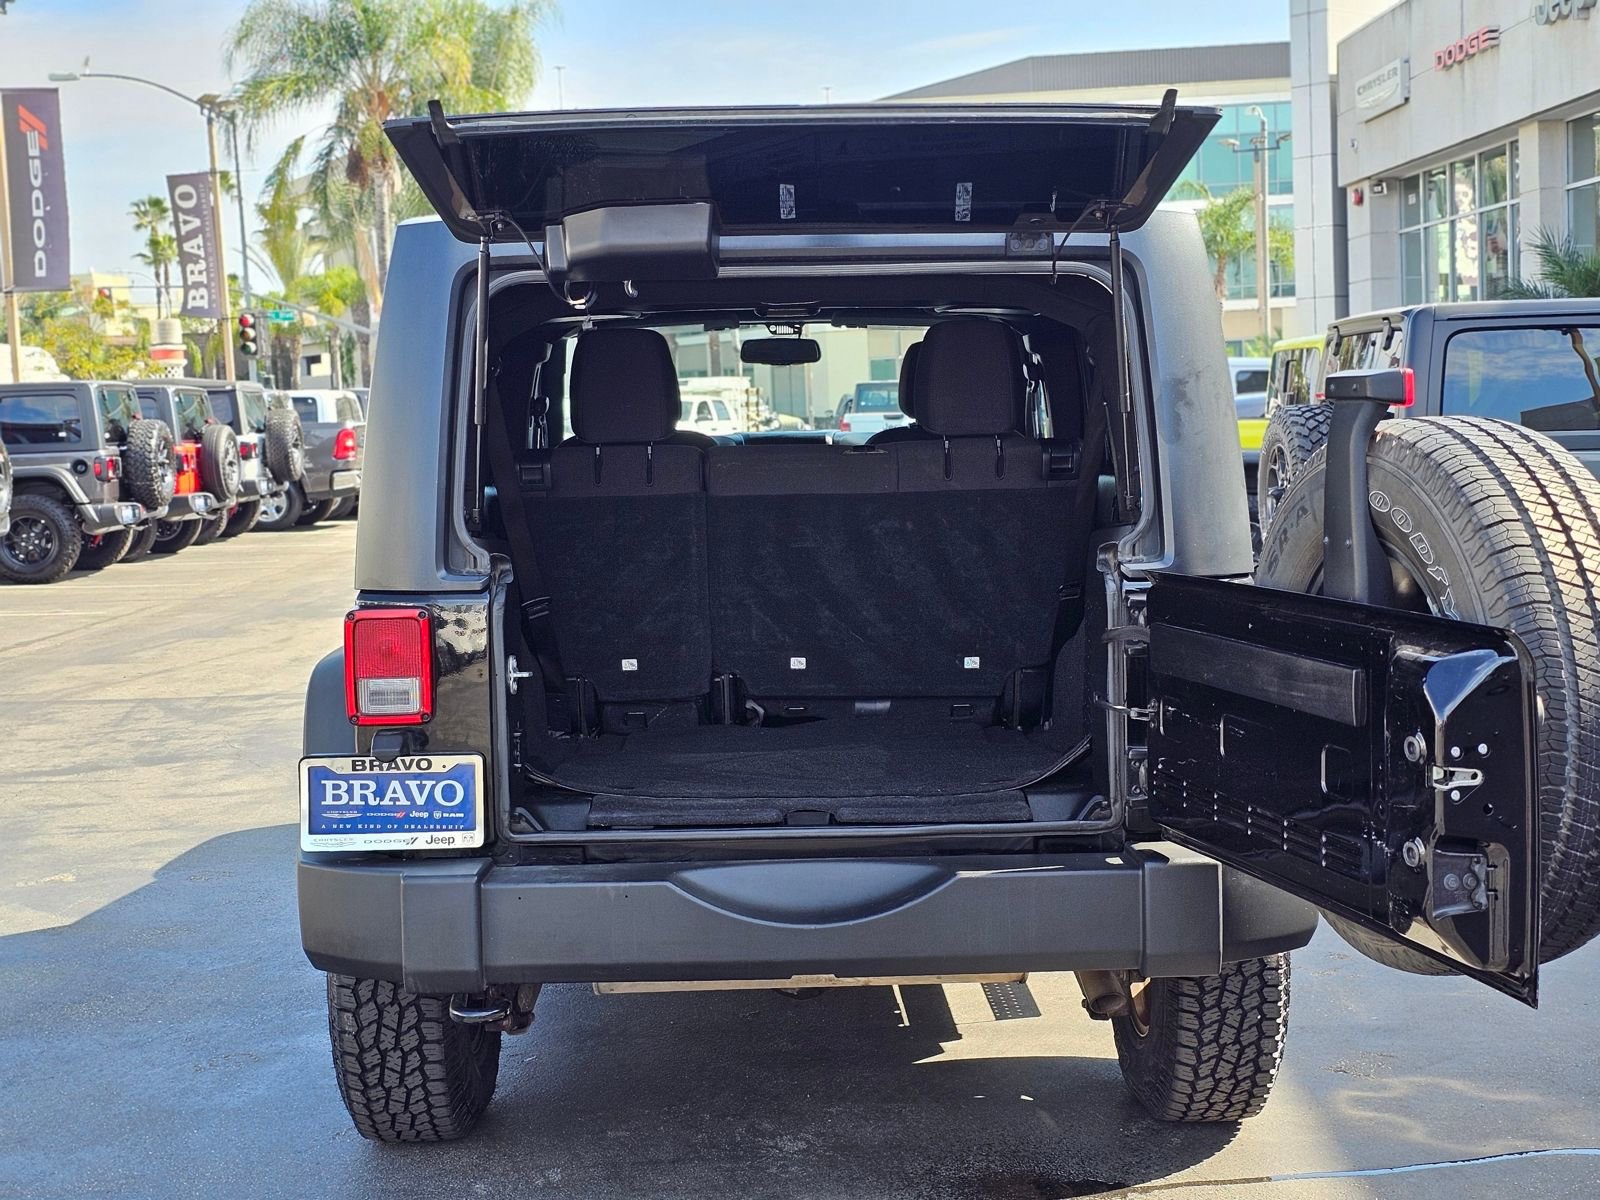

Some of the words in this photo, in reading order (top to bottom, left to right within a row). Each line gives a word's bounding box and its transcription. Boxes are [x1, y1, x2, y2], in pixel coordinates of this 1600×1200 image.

[1434, 26, 1499, 72] DODGE
[1357, 66, 1398, 96] CHRYSLER
[26, 130, 47, 278] DODGE
[174, 184, 209, 309] BRAVO
[351, 758, 433, 771] BRAVO
[320, 779, 465, 807] BRAVO
[409, 810, 429, 819] Jeep
[425, 834, 456, 846] Jeep
